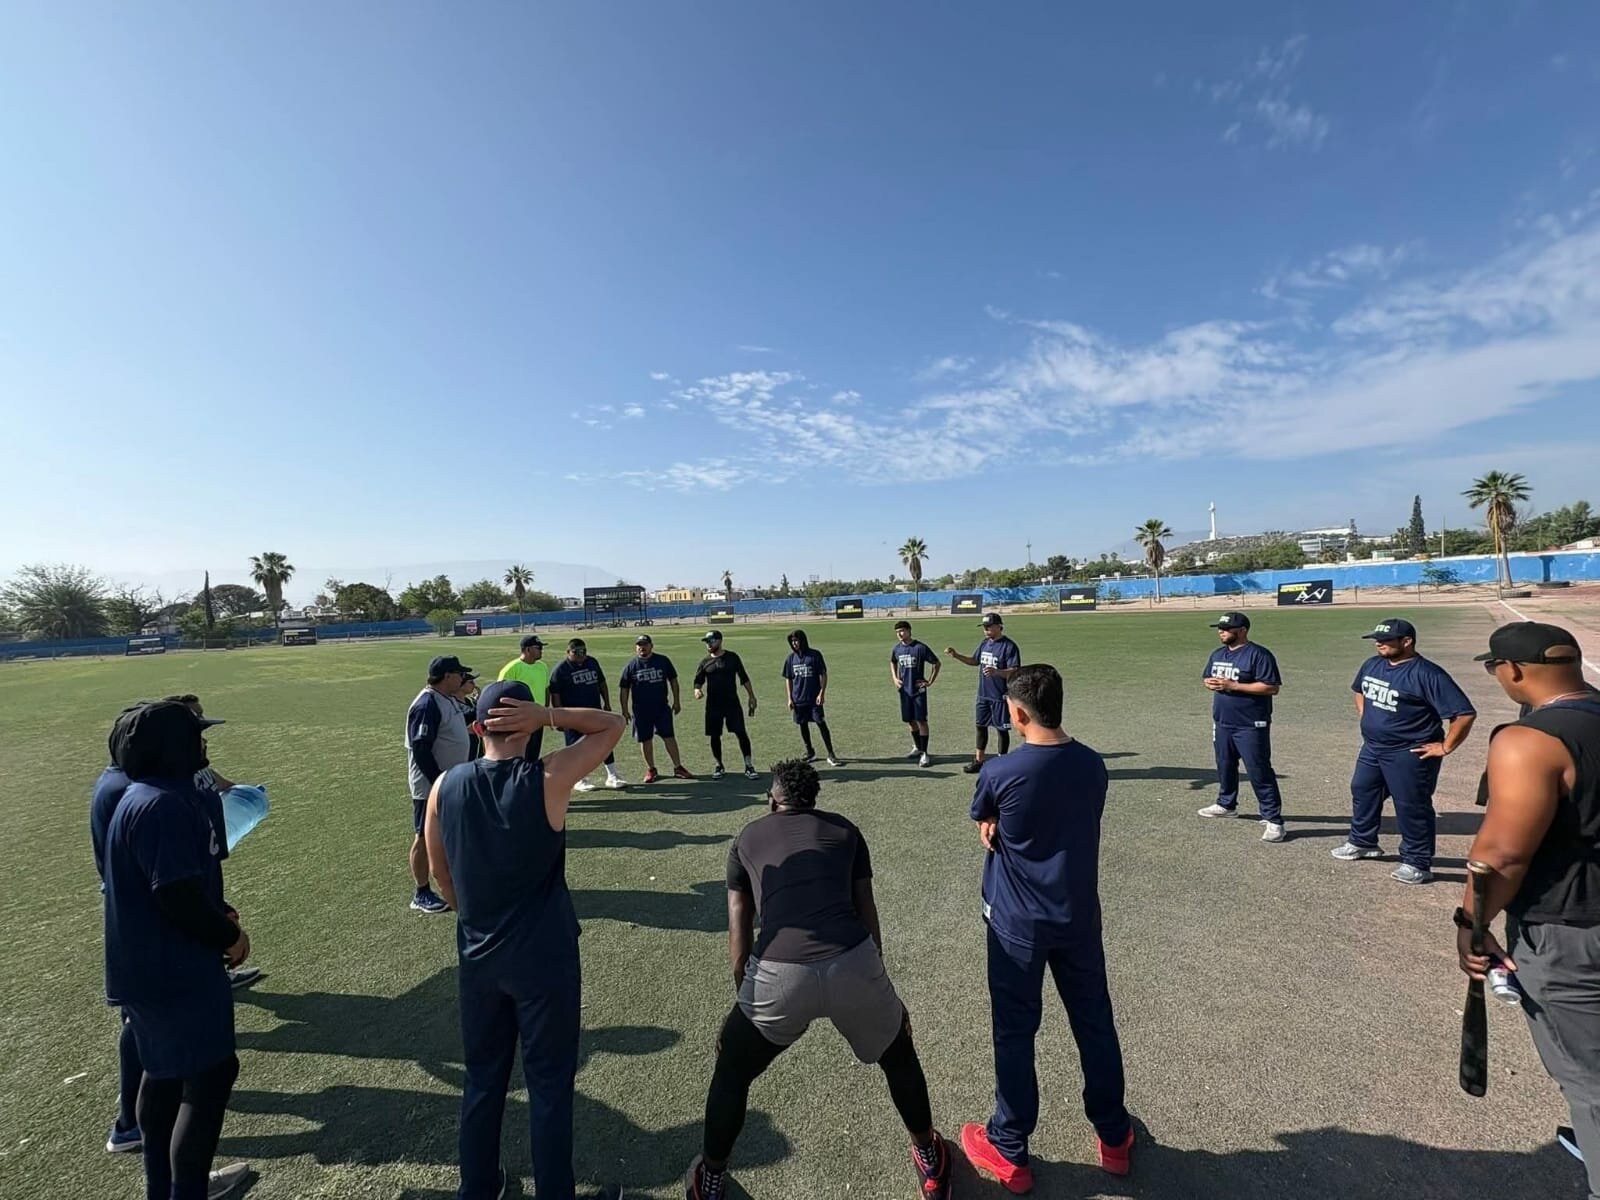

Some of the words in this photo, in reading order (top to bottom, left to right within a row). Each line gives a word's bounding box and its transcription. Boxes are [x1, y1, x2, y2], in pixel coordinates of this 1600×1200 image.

[572, 670, 598, 684] CEUC
[637, 669, 664, 681] CEUC
[1211, 665, 1240, 681] CEUC
[1361, 681, 1400, 706] CEUC
